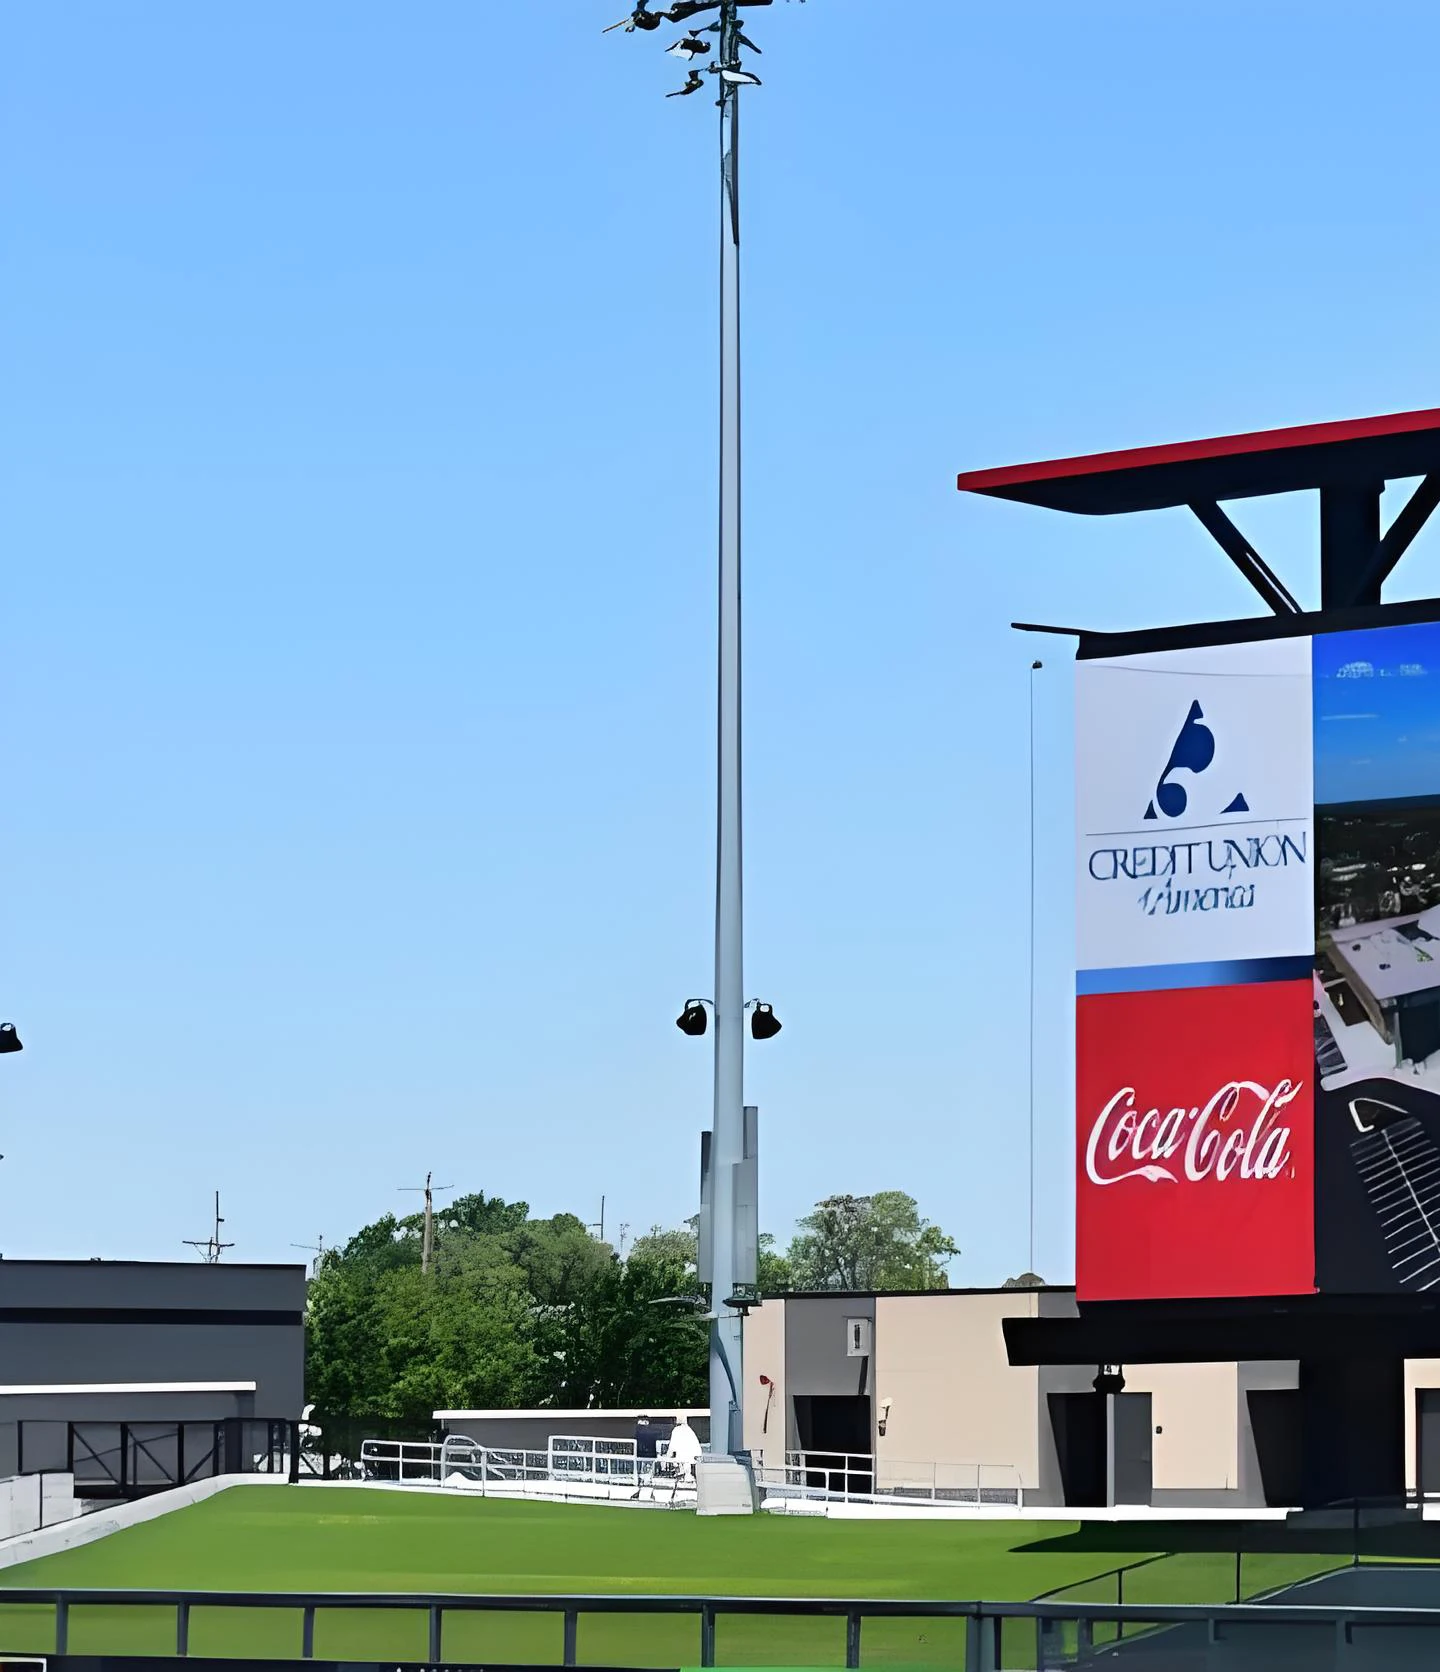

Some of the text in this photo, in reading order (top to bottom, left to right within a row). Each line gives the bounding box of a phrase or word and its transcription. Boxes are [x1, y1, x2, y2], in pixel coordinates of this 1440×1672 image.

[1088, 831, 1306, 881] CREDIT UNION
[1085, 1078, 1304, 1185] Coca-Cola
